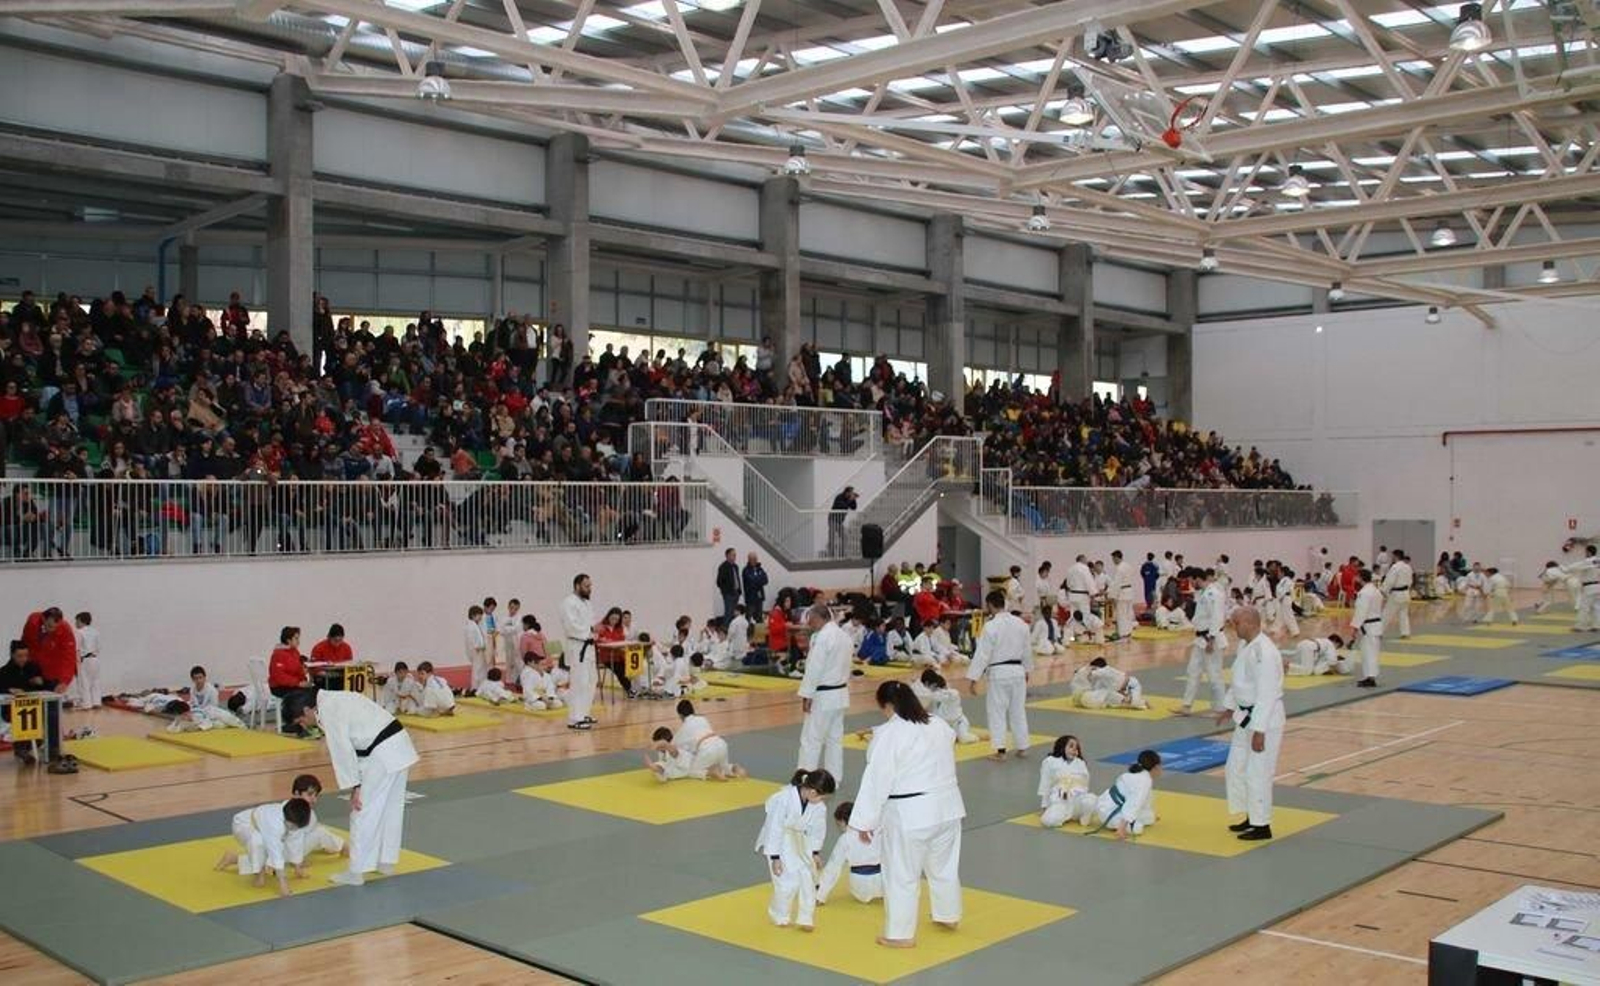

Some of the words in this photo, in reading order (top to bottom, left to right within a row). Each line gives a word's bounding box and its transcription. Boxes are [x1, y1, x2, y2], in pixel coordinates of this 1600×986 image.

[631, 652, 639, 670] 9
[347, 673, 364, 693] 10
[17, 708, 37, 731] 11
